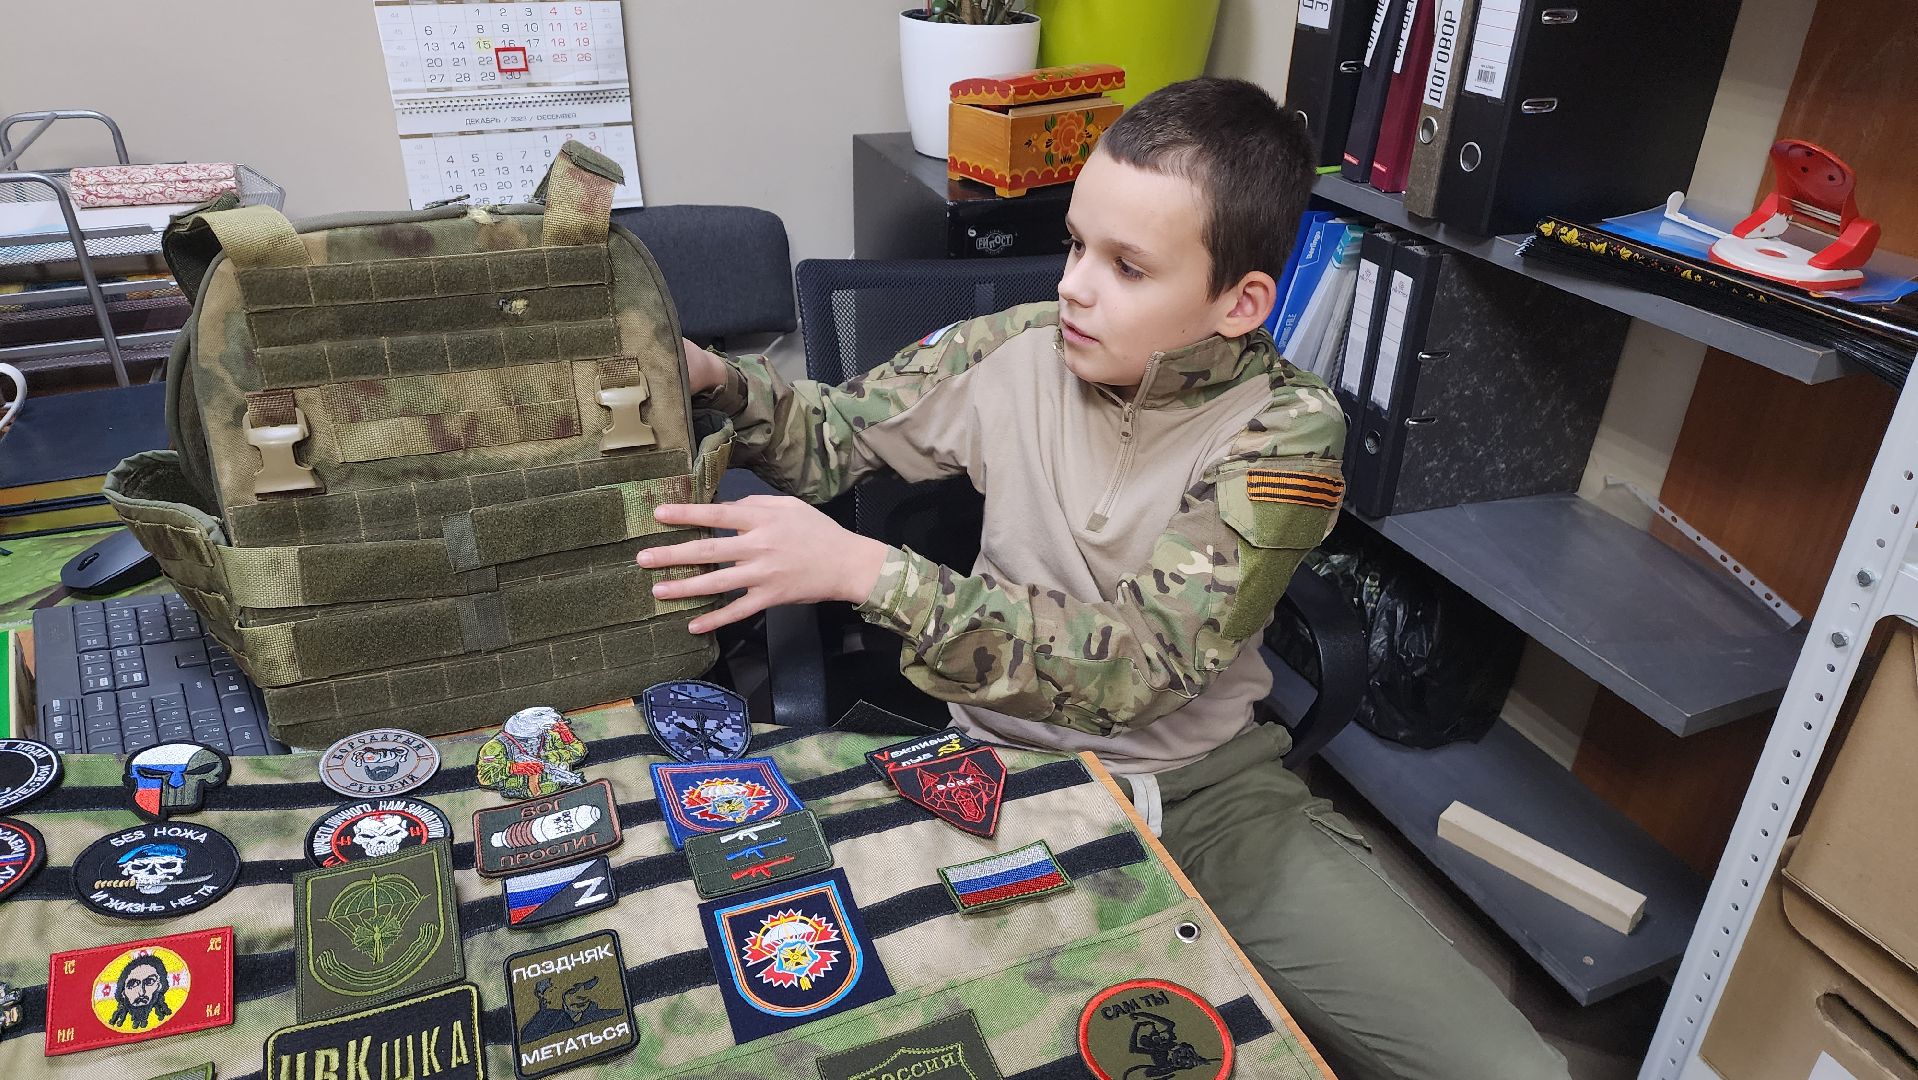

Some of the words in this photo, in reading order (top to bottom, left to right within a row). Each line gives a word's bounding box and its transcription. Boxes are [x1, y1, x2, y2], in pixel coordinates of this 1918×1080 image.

[474, 8, 480, 16] 1
[499, 7, 507, 17] 2
[525, 7, 533, 17] 3
[549, 6, 557, 16] 4
[574, 6, 583, 16] 5
[424, 25, 433, 36] 6
[449, 24, 458, 35] 7
[476, 24, 485, 34] 8
[501, 23, 510, 33] 9
[524, 22, 539, 33] 10
[548, 21, 562, 32] 11
[573, 21, 588, 31] 12
[423, 42, 440, 51] 13
[450, 41, 465, 51] 14
[475, 40, 492, 50] 15
[501, 39, 516, 48] 16
[526, 38, 540, 48] 17
[551, 37, 566, 47] 18
[575, 37, 590, 47] 19
[426, 57, 443, 68] 20
[452, 57, 467, 67] 21
[477, 56, 493, 66] 22
[502, 55, 519, 65] 23
[528, 54, 543, 64] 24
[552, 53, 568, 63] 25
[576, 52, 592, 62] 26
[1429, 10, 1456, 103] ДОГОВОР
[429, 73, 445, 83] 27
[455, 72, 471, 83] 28
[480, 71, 496, 82] 29
[505, 71, 522, 80] 30
[465, 117, 500, 126] ДЕКАБРЬ
[536, 112, 577, 121] DECEMBER
[543, 135, 548, 143] 1
[588, 131, 597, 141] 3
[446, 155, 455, 164] 4
[471, 153, 480, 163] 5
[496, 152, 504, 162] 6
[521, 150, 528, 160] 7
[544, 149, 551, 158] 8
[446, 170, 460, 179] 11
[470, 168, 485, 177] 12
[495, 166, 510, 176] 13
[519, 164, 534, 174] 14
[448, 184, 463, 193] 18
[473, 183, 488, 192] 19
[496, 181, 512, 190] 20
[521, 179, 535, 188] 21
[499, 195, 514, 204] 27
[12, 742, 50, 760] ЛЮДИ
[332, 734, 425, 760] БОРОДАТЫЙ
[110, 830, 147, 847] БЕЗ
[153, 827, 208, 844] НОЖА
[500, 832, 600, 867] ПРОСТИТ
[89, 890, 109, 903] И
[103, 897, 166, 914] ЖИЗНЬ
[170, 894, 197, 910] НЕ
[194, 883, 220, 898] ТА
[572, 876, 609, 908] Z
[512, 943, 614, 983] ПОЗДНЯК
[1100, 998, 1141, 1021] САМ
[1139, 990, 1170, 1008] ТЫ
[521, 1022, 630, 1067] МЕТАТЬСЯ
[867, 1052, 961, 1080] ОССИЯ
